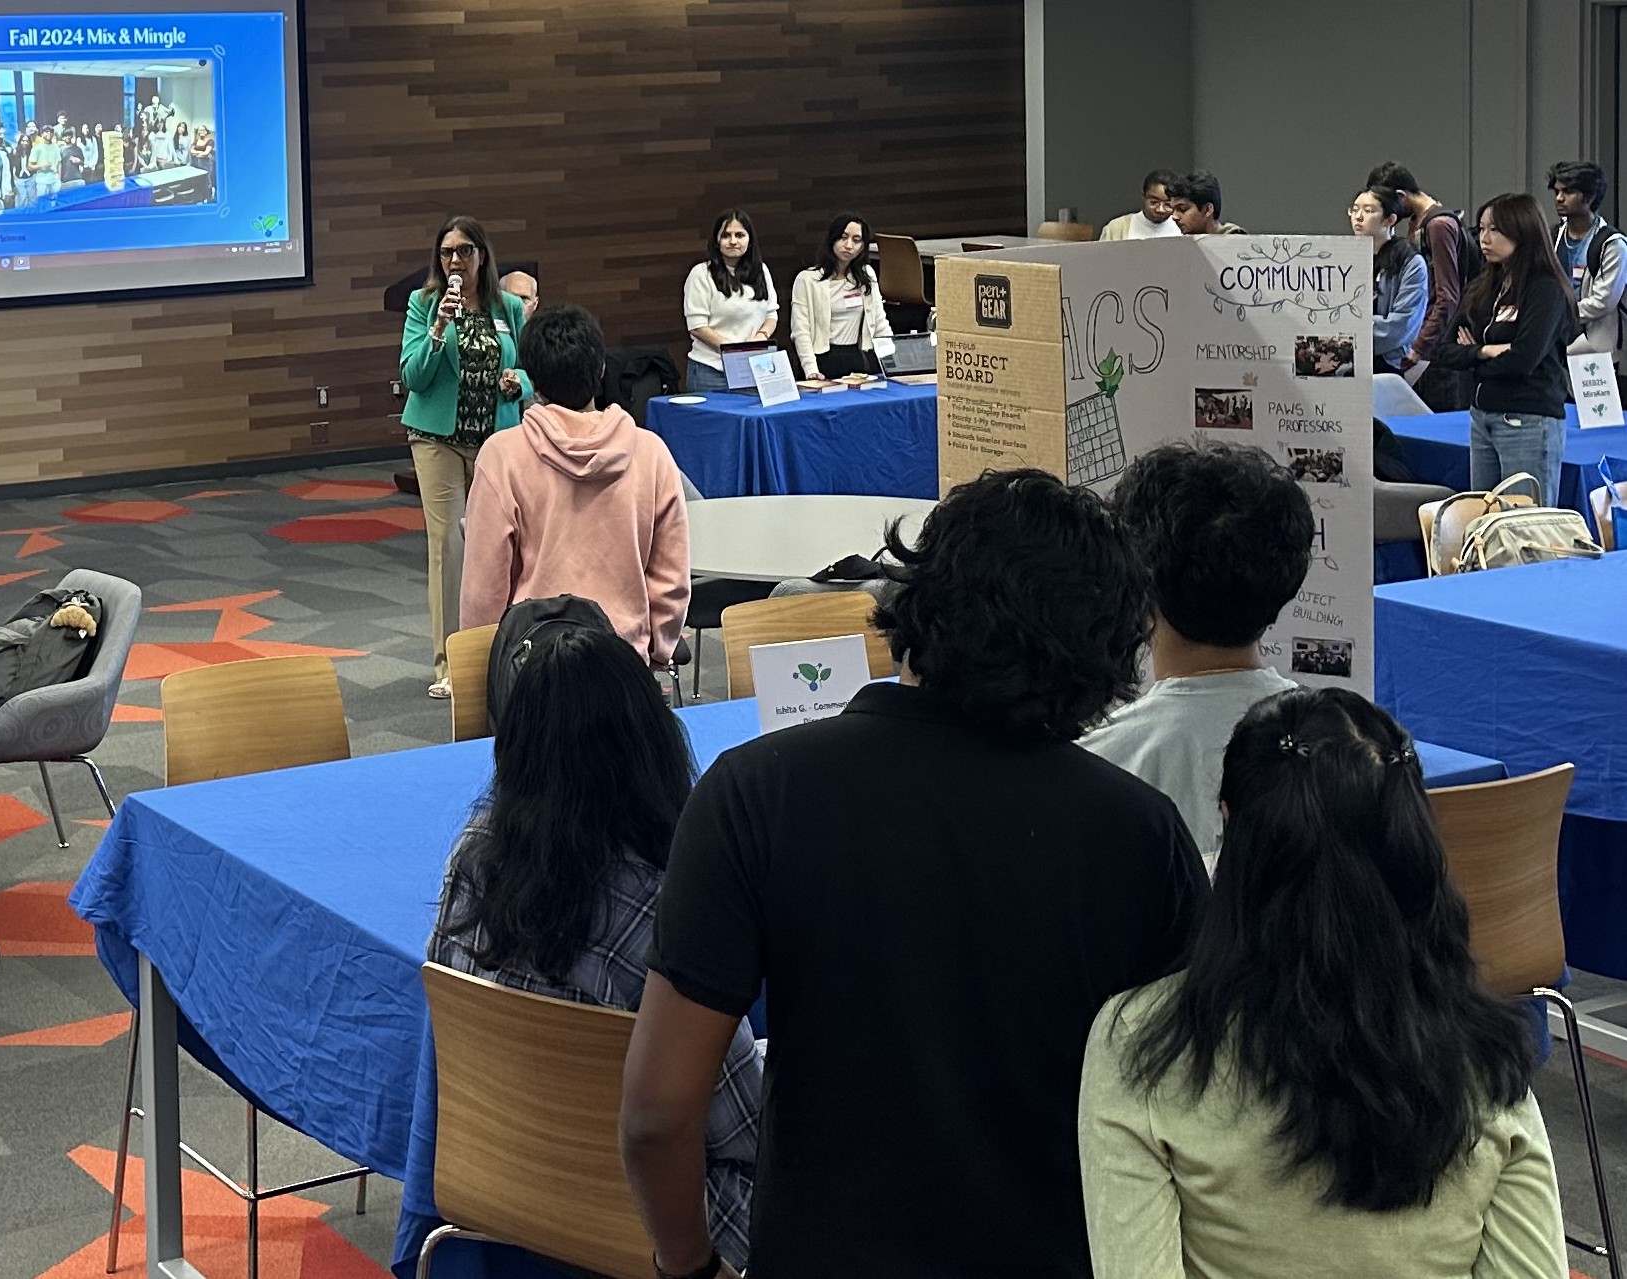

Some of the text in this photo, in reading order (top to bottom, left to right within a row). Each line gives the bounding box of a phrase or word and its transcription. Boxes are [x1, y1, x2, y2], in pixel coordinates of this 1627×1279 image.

[9, 26, 186, 48] Fall 2024 Mix & Mingle
[1220, 264, 1353, 292] COMMUNITY
[981, 298, 1007, 320] GEAR
[945, 341, 976, 351] TRI-FOLD
[1196, 343, 1277, 361] MENTORSHIP
[945, 350, 1008, 370] PROJECT
[945, 365, 994, 384] BOARD
[1268, 401, 1304, 416] PAWS
[1278, 418, 1342, 433] PROFESSORS
[1292, 606, 1343, 627] BUILDING
